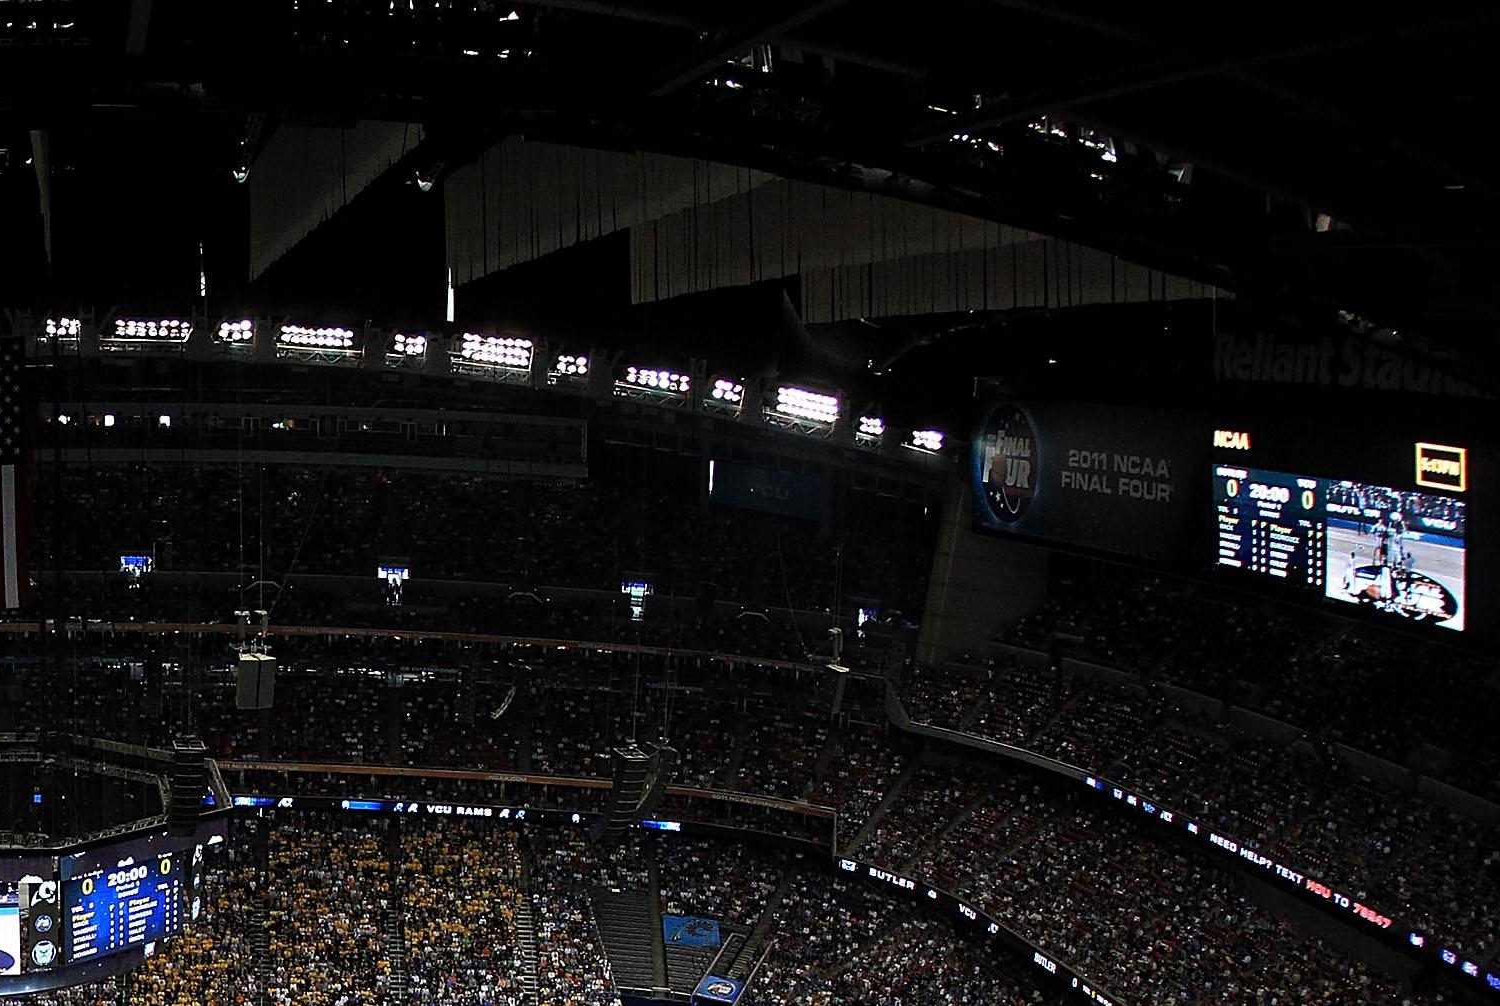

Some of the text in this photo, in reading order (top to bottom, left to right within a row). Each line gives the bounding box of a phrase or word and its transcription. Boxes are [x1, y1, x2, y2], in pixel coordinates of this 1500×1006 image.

[1213, 430, 1251, 450] NCAA
[1068, 449, 1171, 478] 2011 NCAA
[1061, 471, 1173, 503] FINAL FOUR
[1227, 479, 1238, 497] 0
[1249, 483, 1289, 503] 20:00
[1302, 490, 1314, 509] 0
[1219, 514, 1239, 524] Player
[1270, 523, 1292, 534] Player
[426, 804, 493, 817] VCU RAMS
[160, 858, 171, 875] 0
[1210, 833, 1237, 853] NEED
[1240, 847, 1272, 869] HELP?
[1275, 864, 1303, 884] TEXT
[1306, 879, 1331, 899] HOU
[1333, 893, 1350, 908] TO
[107, 865, 148, 887] 20:00
[868, 867, 915, 890] BUTLER
[82, 878, 93, 895] 0
[128, 896, 150, 907] Player
[72, 911, 95, 923] Player
[959, 903, 976, 920] VCU
